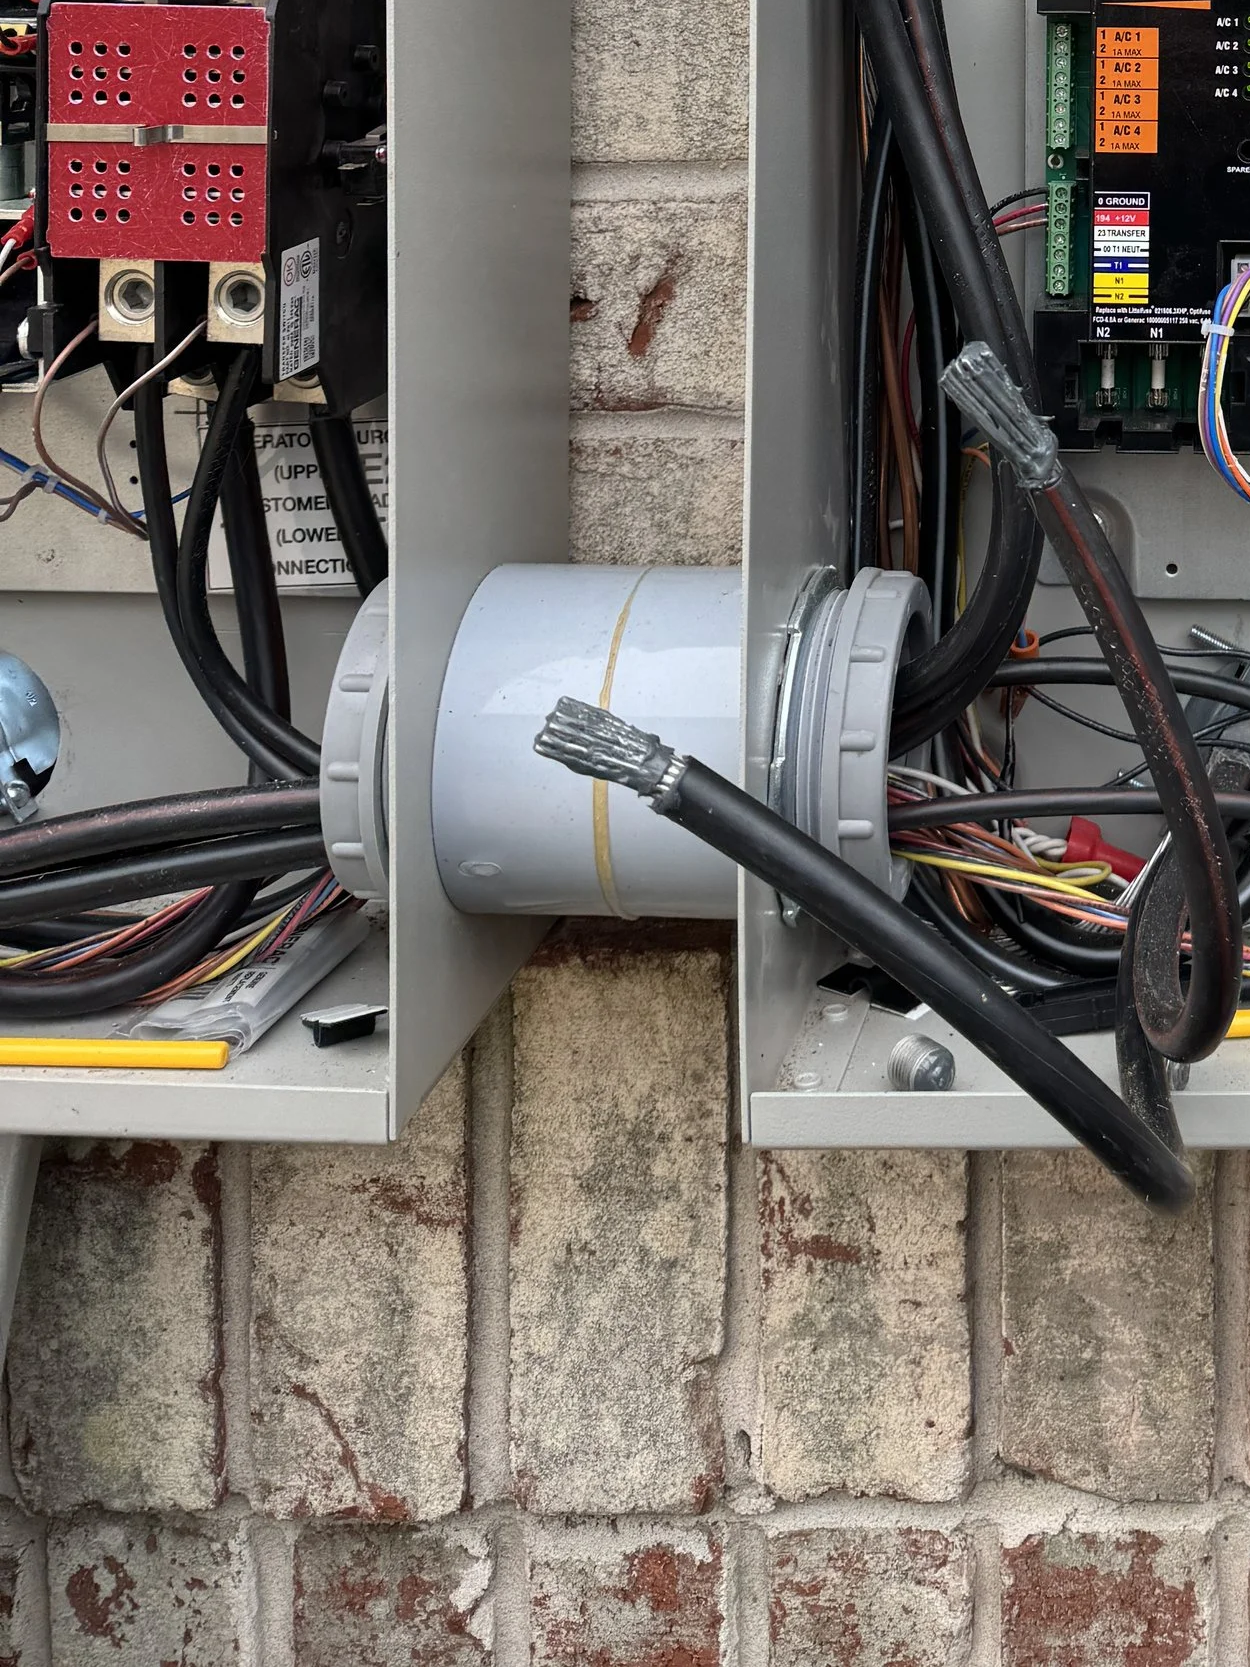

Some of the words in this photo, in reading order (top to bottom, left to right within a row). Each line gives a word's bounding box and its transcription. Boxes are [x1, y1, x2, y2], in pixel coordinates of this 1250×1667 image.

[1217, 18, 1231, 26] A/C
[1234, 18, 1238, 26] 1
[1115, 32, 1132, 42] A/C
[1135, 32, 1140, 41] 1
[1216, 42, 1230, 50] A/C
[1232, 42, 1238, 50] 2
[1114, 63, 1132, 72] A/C
[1134, 63, 1141, 72] 2
[1215, 88, 1229, 97] A/C
[1232, 89, 1237, 97] 4
[1114, 126, 1131, 136] A/C
[1133, 126, 1140, 135] 4
[1097, 327, 1110, 337] N2
[1150, 328, 1163, 338] N1
